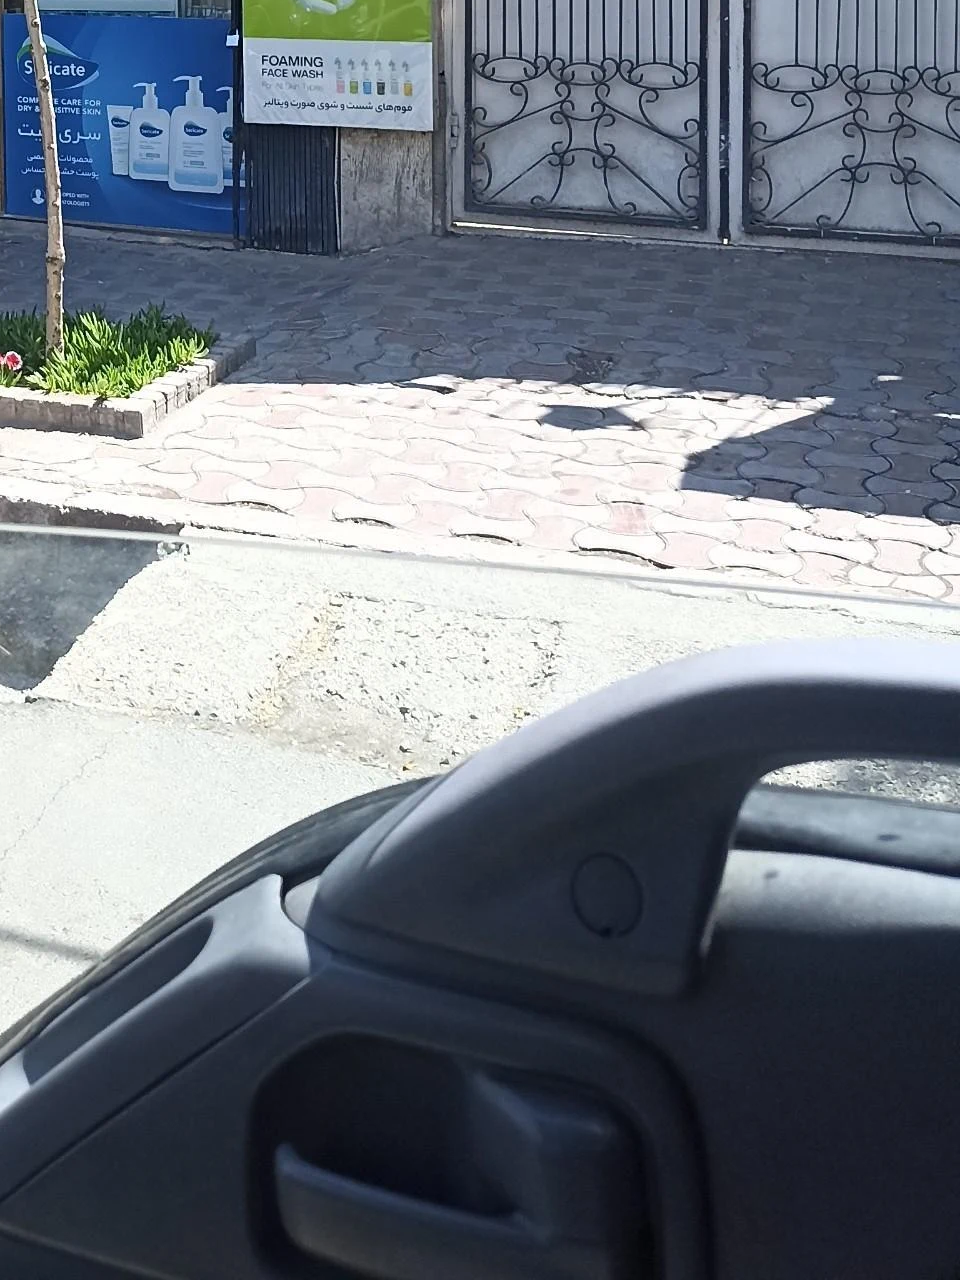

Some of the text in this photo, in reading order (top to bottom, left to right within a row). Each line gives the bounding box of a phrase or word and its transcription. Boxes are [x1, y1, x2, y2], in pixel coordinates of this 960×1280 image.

[261, 55, 324, 67] FOAMING
[24, 60, 86, 77] Sicate
[261, 68, 324, 78] FACE WASH
[61, 98, 82, 106] CARE
[84, 99, 101, 107] FOR
[54, 107, 81, 115] SITIVE
[82, 108, 101, 116] SKIN
